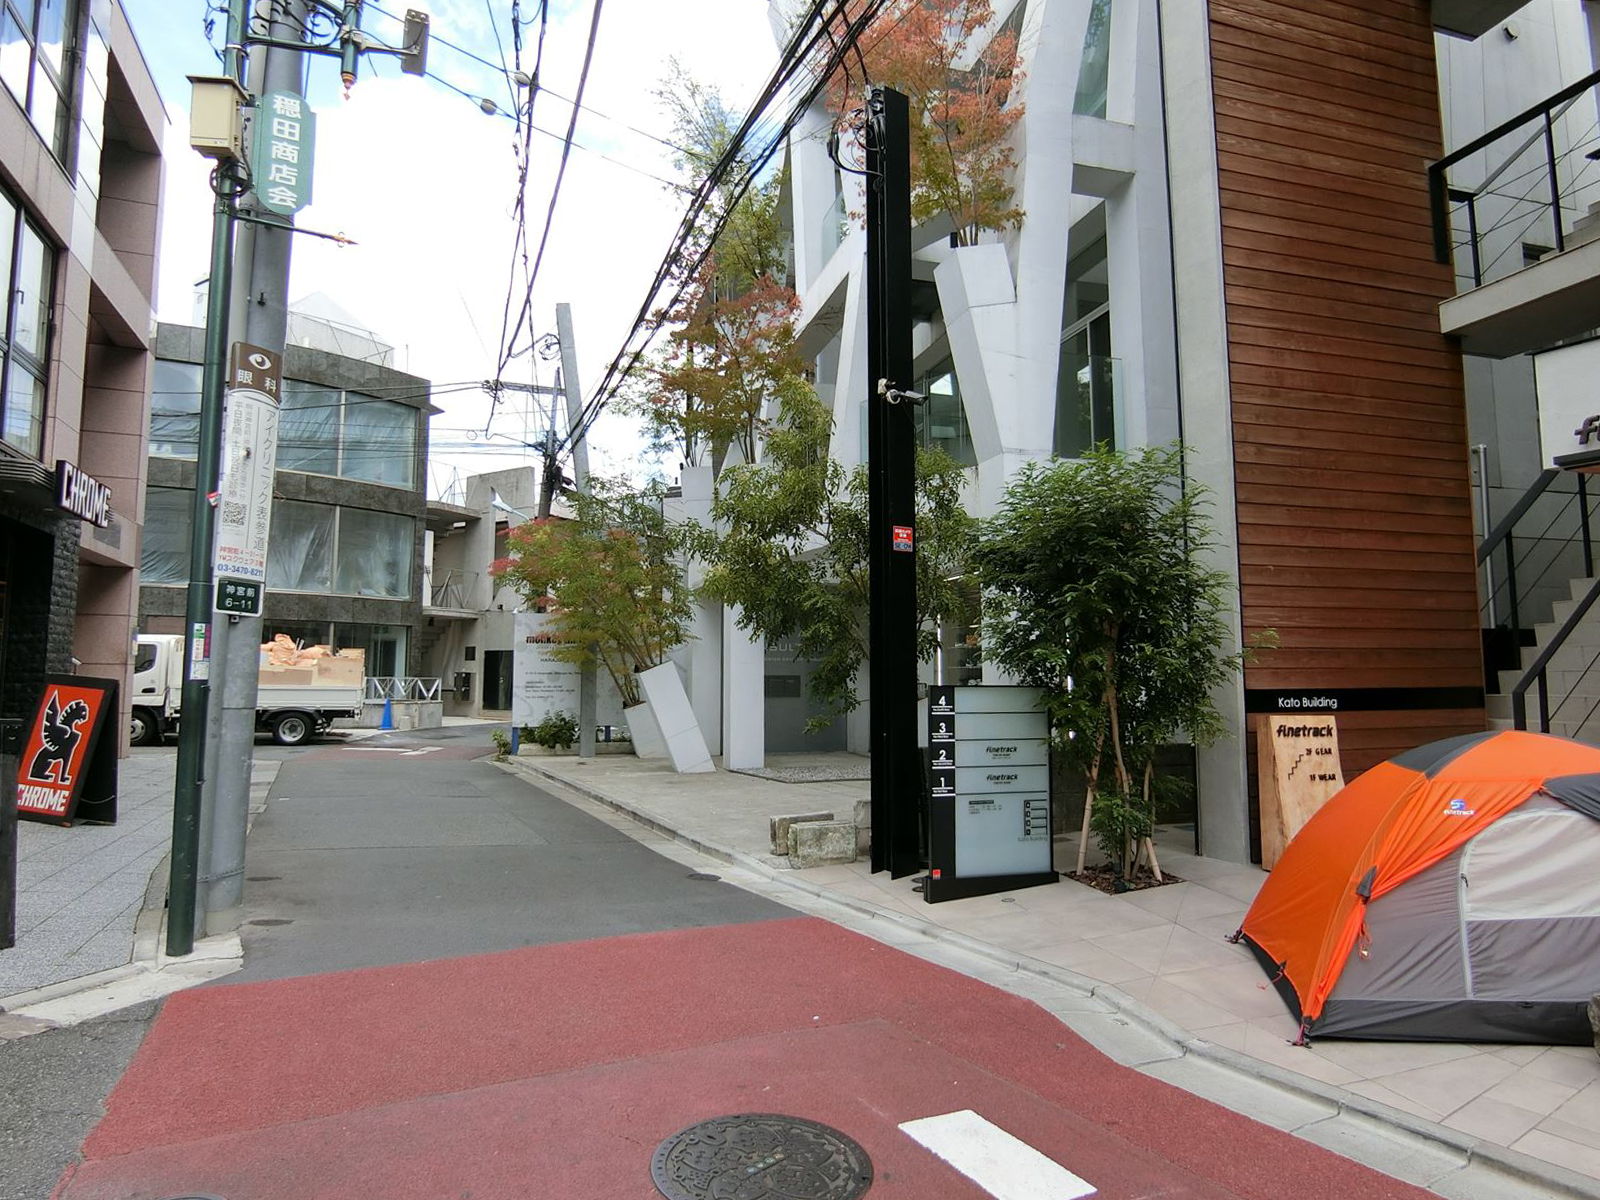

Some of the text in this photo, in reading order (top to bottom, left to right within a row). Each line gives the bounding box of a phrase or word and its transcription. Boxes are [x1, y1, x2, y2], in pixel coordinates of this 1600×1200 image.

[237, 369, 277, 393] 眼科
[62, 462, 111, 527] CHROME
[226, 584, 255, 598] 神宮前
[225, 597, 252, 609] 6-11
[938, 695, 946, 706] 4
[1278, 696, 1338, 709] Kato Building
[939, 722, 946, 733] 3
[1276, 724, 1334, 738] finetrack
[939, 749, 946, 760] 2
[1305, 748, 1312, 756] 2F
[940, 777, 945, 788] 1
[1318, 773, 1337, 781] WEAR
[17, 784, 69, 812] CHROME
